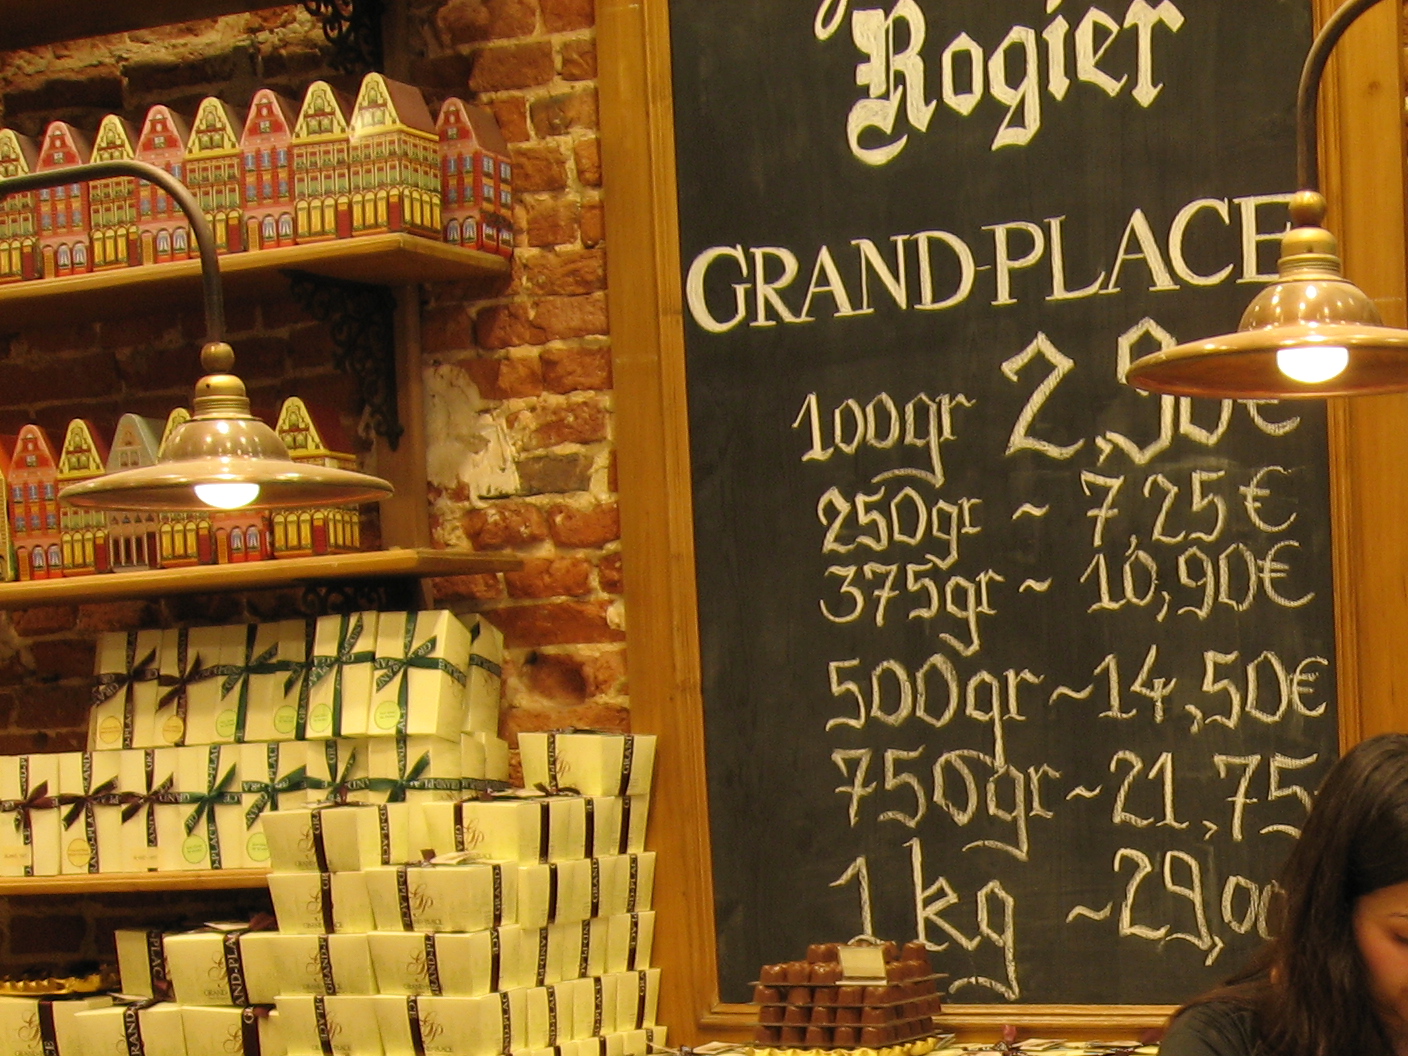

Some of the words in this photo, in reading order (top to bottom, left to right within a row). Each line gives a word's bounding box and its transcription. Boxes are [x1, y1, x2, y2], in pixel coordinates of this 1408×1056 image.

[847, 0, 1185, 166] Rogier
[685, 193, 1290, 334] GRAND-PLACE
[792, 391, 976, 488] 100gr
[817, 485, 983, 569] 250gr
[819, 562, 1004, 657] 375gr
[825, 652, 1045, 768] 500gr
[831, 745, 1063, 862] 750gr
[828, 855, 897, 947] 1
[902, 837, 1021, 1001] kg
